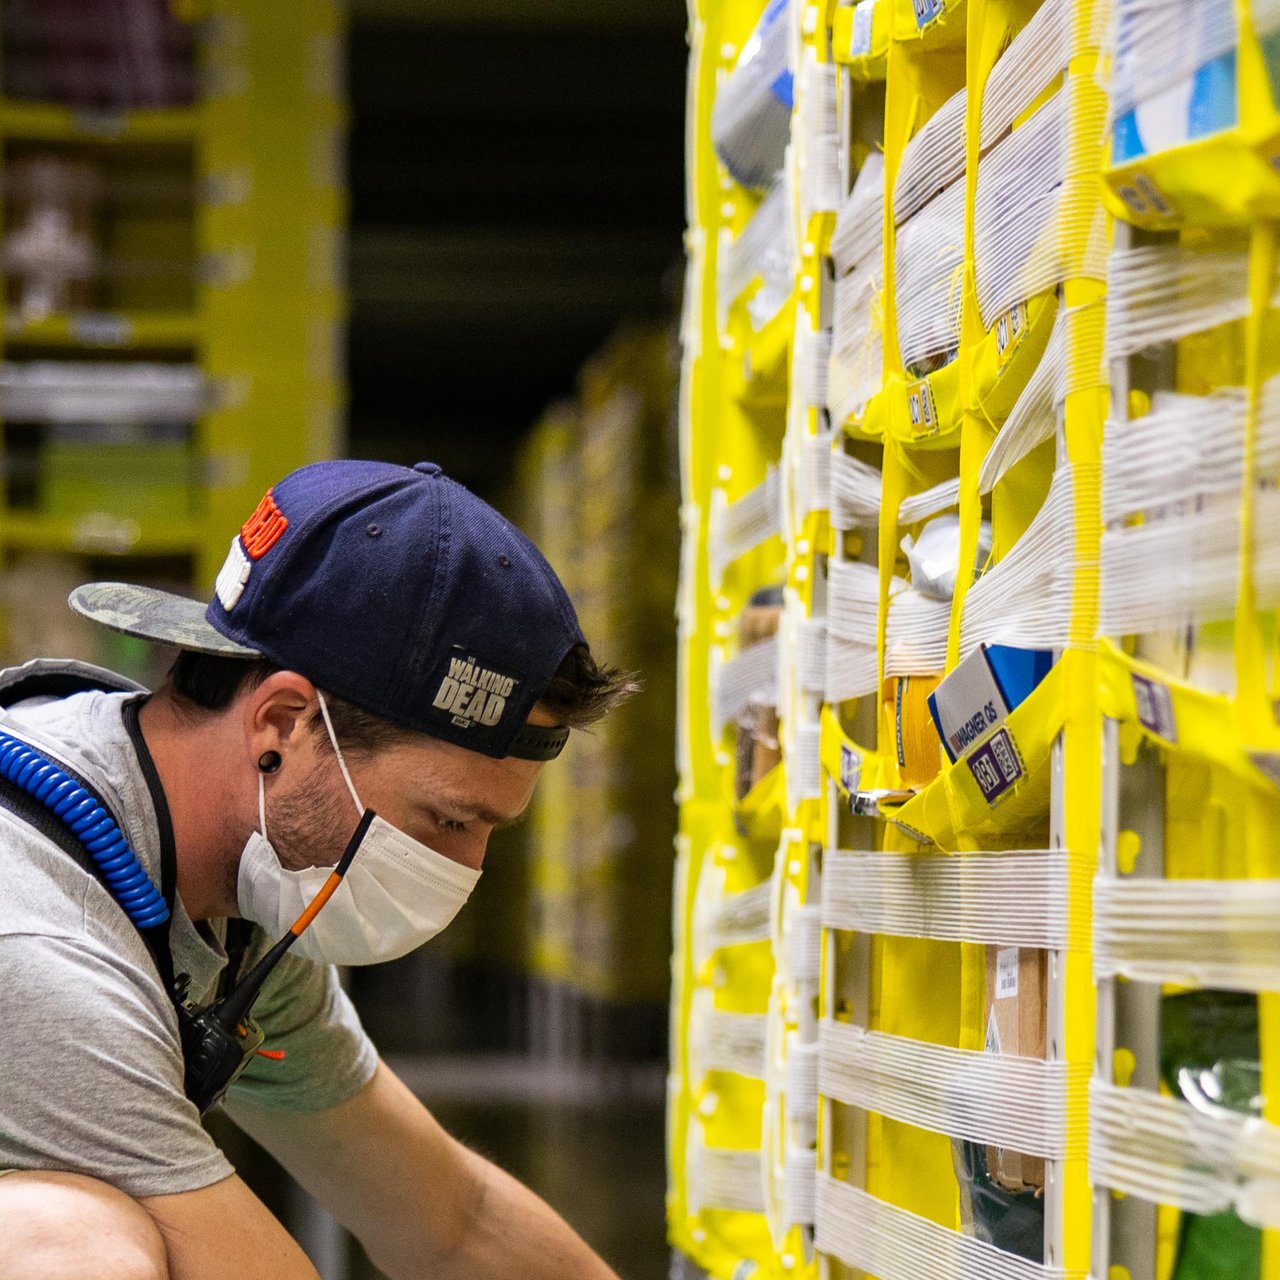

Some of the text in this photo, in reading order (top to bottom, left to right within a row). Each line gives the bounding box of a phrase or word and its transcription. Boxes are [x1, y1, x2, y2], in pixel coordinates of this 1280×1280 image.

[448, 657, 515, 698] WALKING
[432, 676, 506, 726] DEAD
[955, 711, 987, 749] WAGNER
